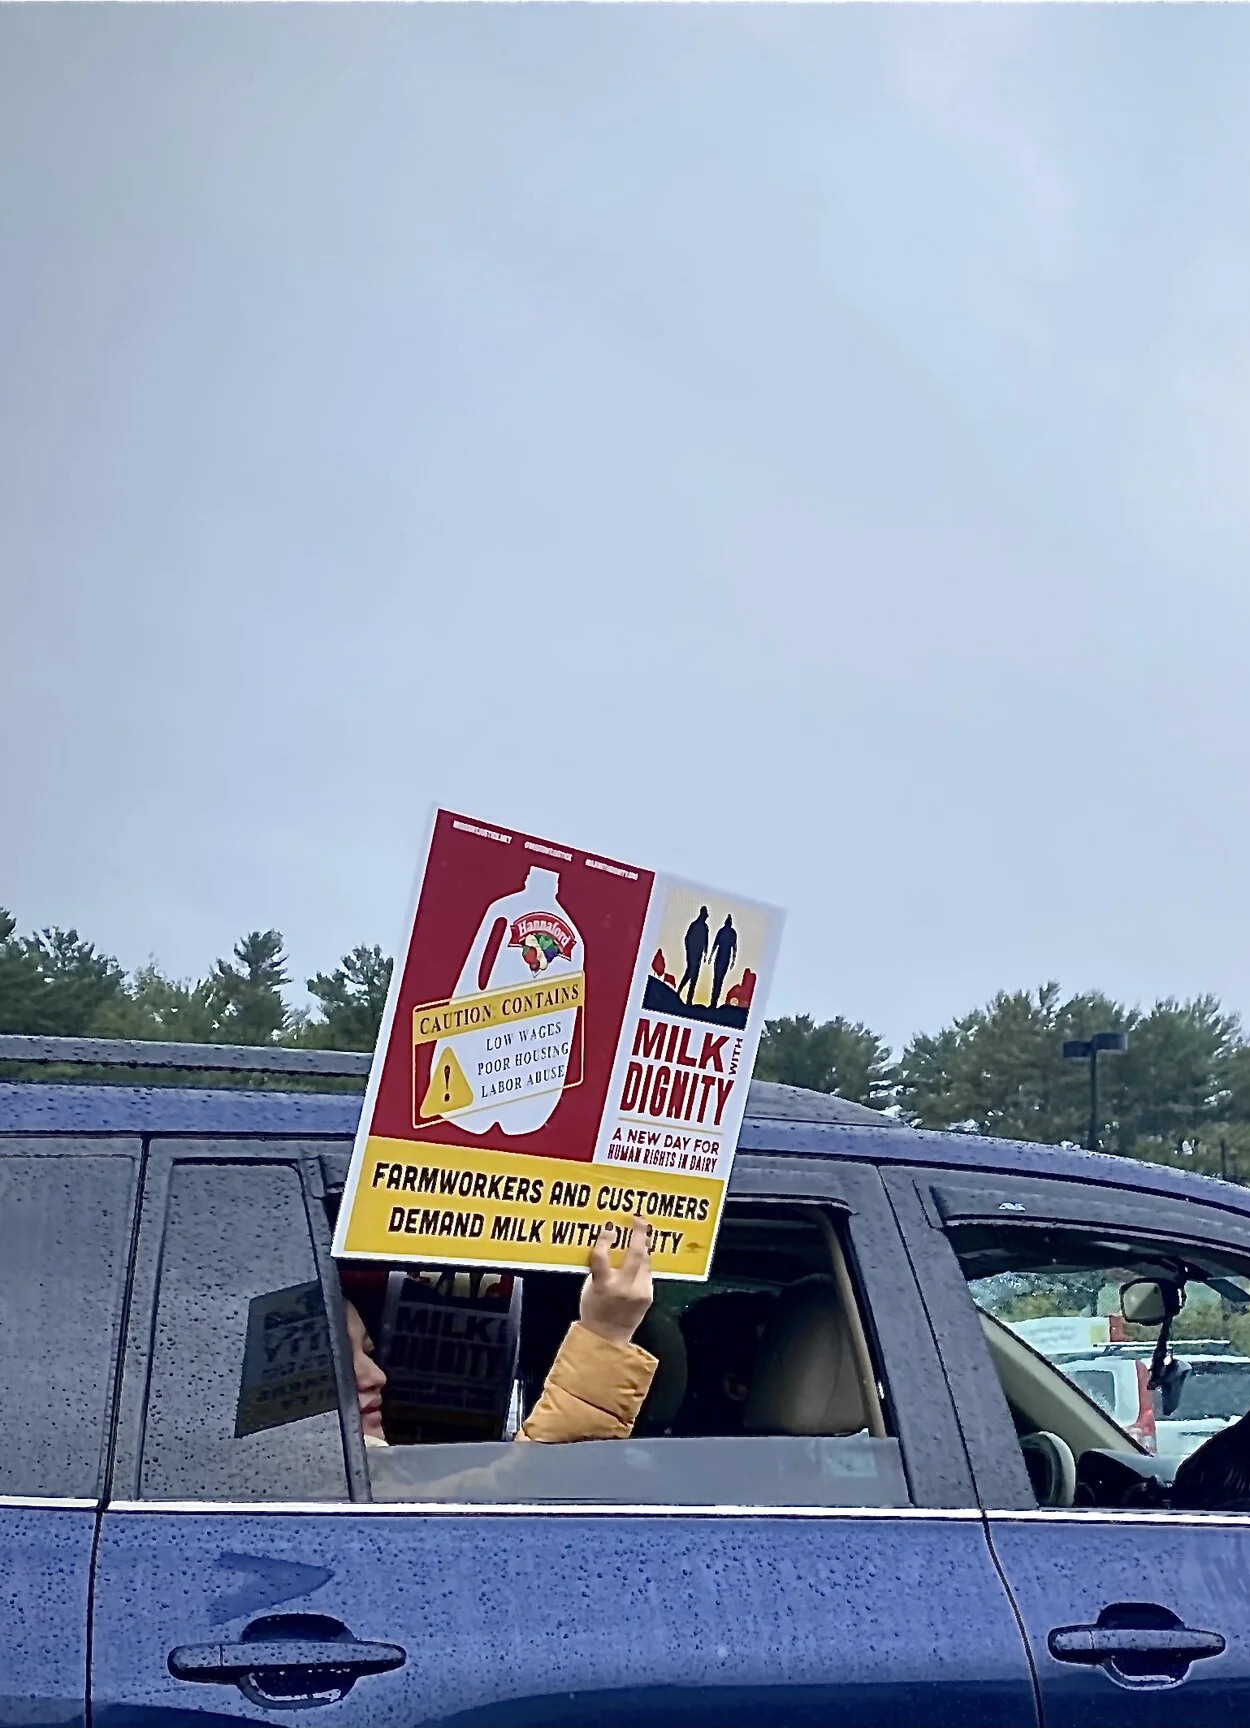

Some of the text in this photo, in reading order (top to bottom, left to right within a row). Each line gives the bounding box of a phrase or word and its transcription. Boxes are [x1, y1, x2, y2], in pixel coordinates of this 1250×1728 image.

[518, 918, 571, 948] Hannaford
[420, 984, 580, 1035] CAUTION CONTAINS
[486, 1021, 562, 1052] LOW WAGES
[631, 1017, 731, 1073] MILK
[478, 1042, 570, 1076] POOR HOUSING
[727, 1037, 744, 1076] WITH
[481, 1064, 566, 1099] LABOR ABUSE
[619, 1061, 735, 1126] DIGNITY
[607, 1143, 718, 1173] HUMAN RIGHTS IN DAIRY
[612, 1127, 720, 1156] A NEW DAY FOR
[372, 1162, 710, 1221] FARMWORKERS AND CUSTOMERS
[388, 1206, 684, 1255] DEMAND MILK WITH DIITY
[396, 1307, 492, 1343] MILK
